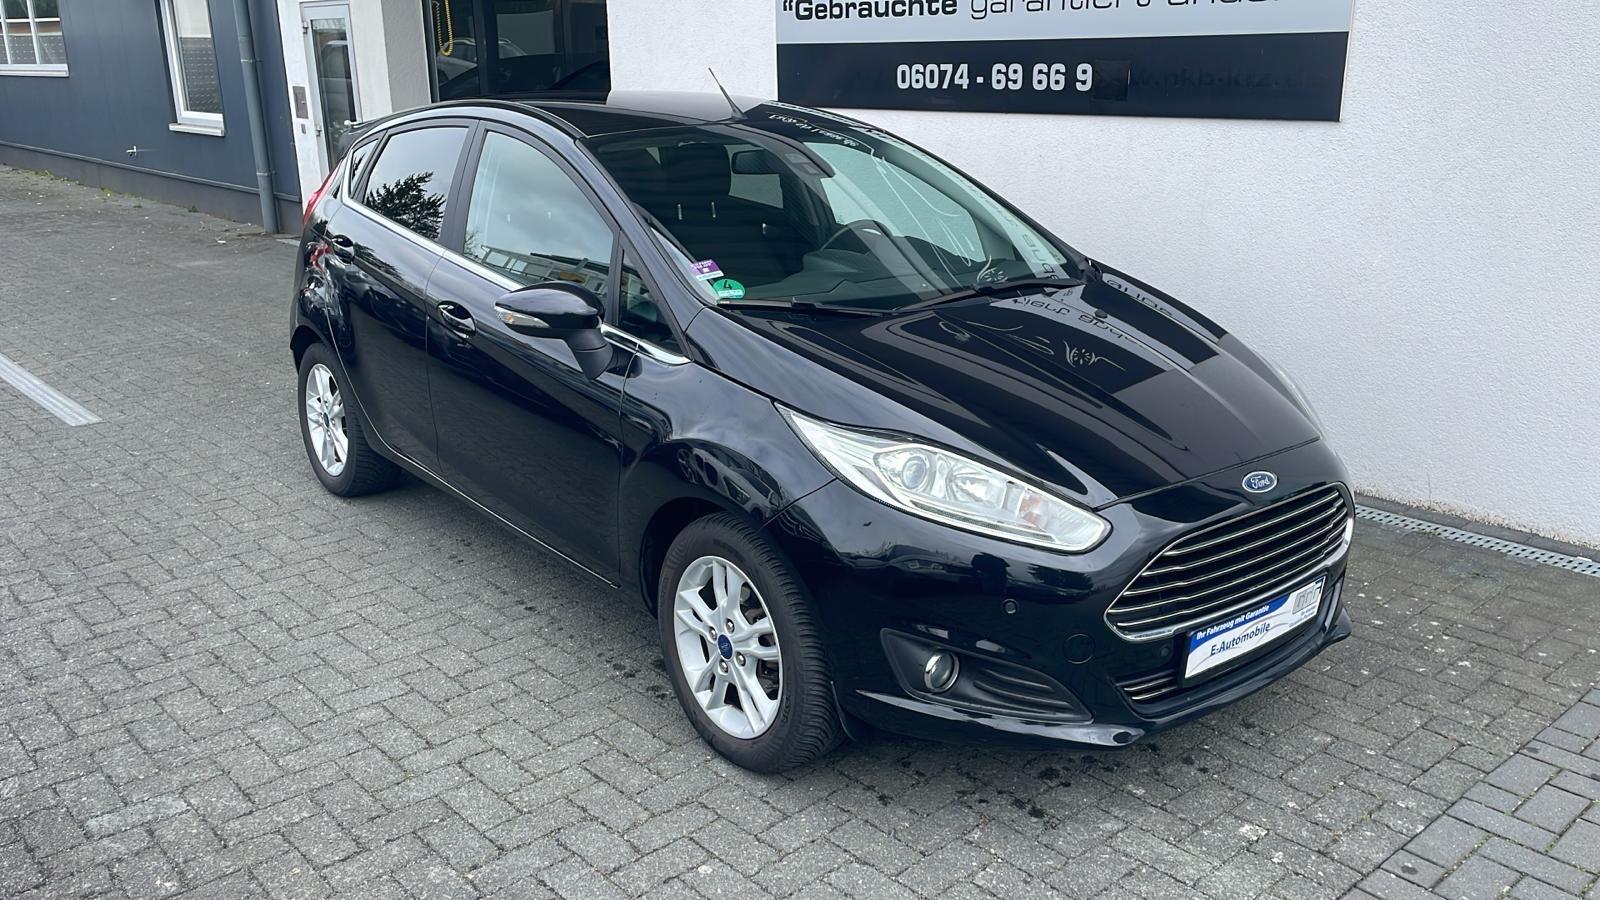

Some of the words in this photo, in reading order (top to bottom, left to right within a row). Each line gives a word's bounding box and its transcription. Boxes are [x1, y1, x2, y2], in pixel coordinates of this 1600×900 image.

[896, 63, 970, 90] 06074
[976, 75, 985, 84] -
[991, 63, 1024, 91] 69
[1032, 63, 1066, 91] 66
[1075, 63, 1094, 92] 9
[723, 279, 733, 290] 4
[1250, 475, 1271, 489] Ford
[1196, 631, 1206, 640] Ihr
[1206, 619, 1235, 636] Fahrzeug
[1234, 614, 1246, 624] mit
[1245, 605, 1270, 620] Garantie
[1210, 622, 1271, 656] E-Automobile
